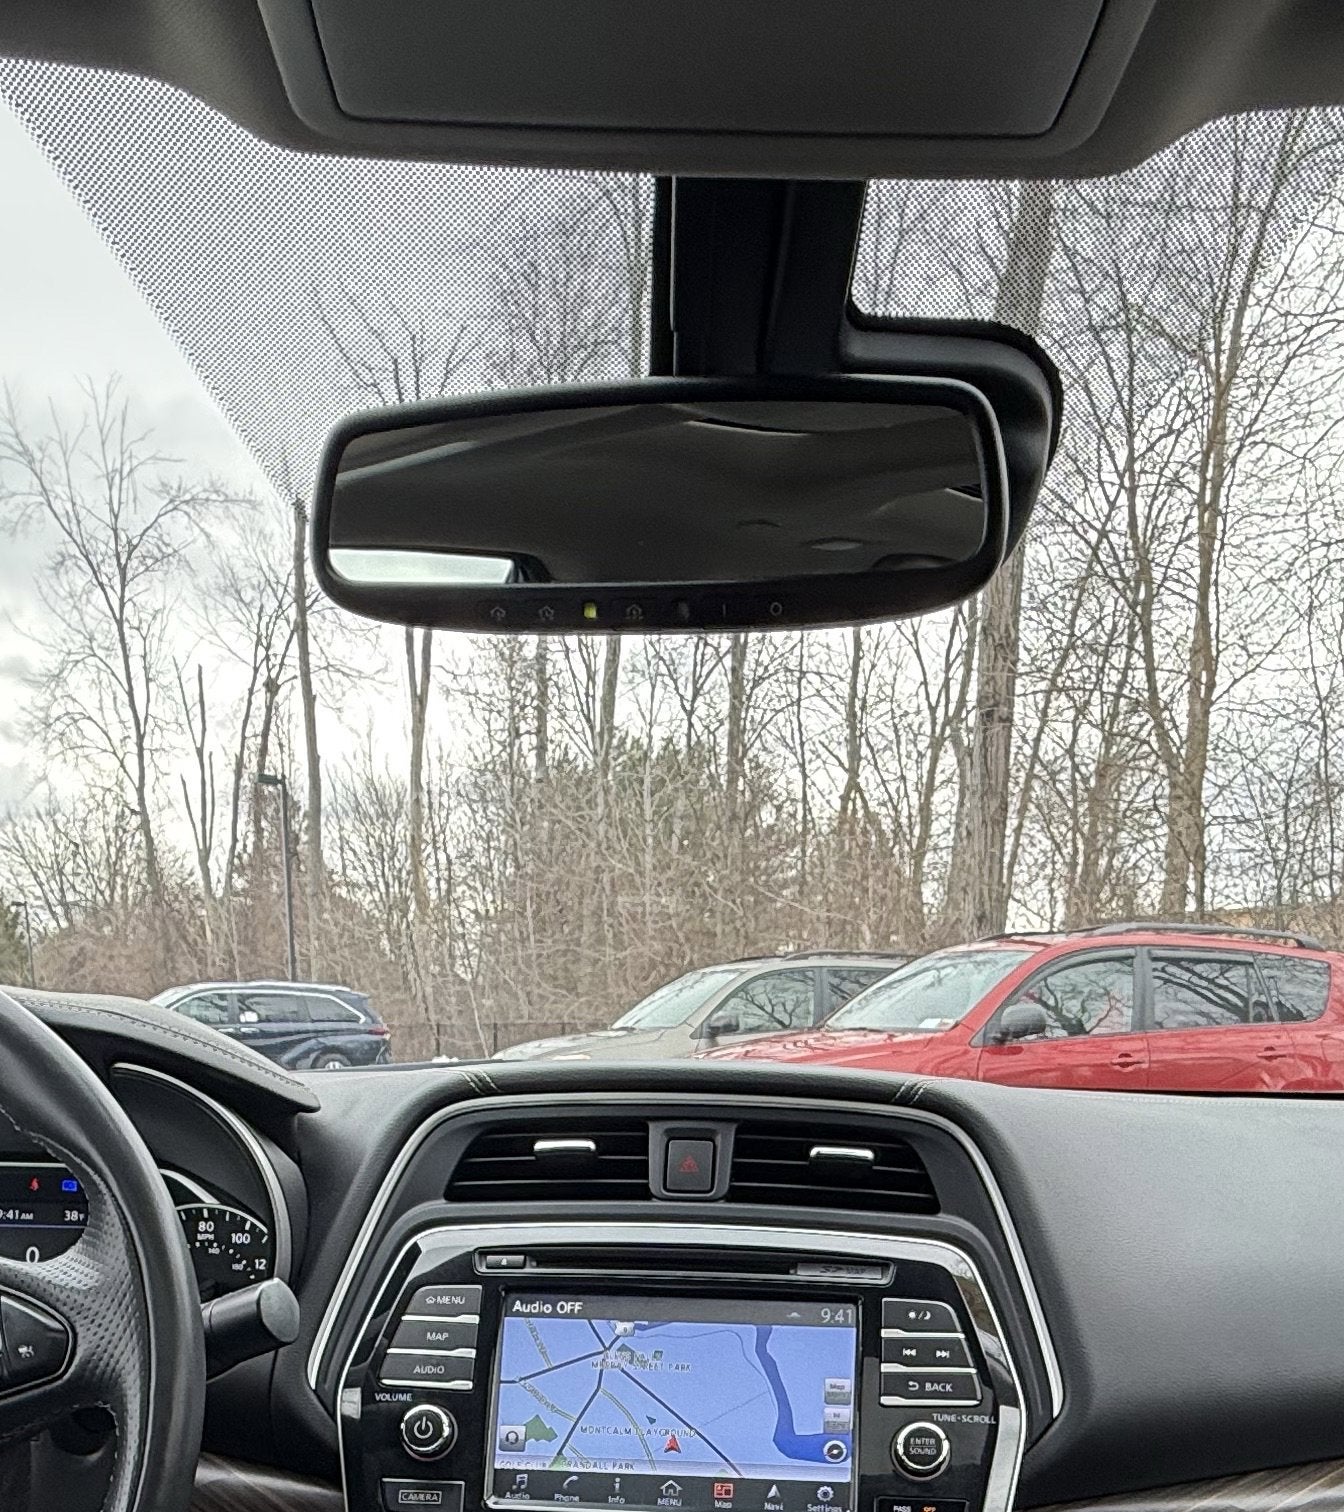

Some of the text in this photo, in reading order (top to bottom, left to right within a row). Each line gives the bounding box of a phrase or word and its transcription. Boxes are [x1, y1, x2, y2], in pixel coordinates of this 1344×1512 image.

[198, 1220, 215, 1233] 80
[231, 1232, 251, 1245] 100
[436, 1295, 466, 1305] MENU
[512, 1299, 584, 1315] Audio OFF
[820, 1307, 855, 1324] 9:41
[426, 1331, 449, 1341] MAP
[412, 1365, 445, 1375] AUDIO
[924, 1382, 953, 1393] BACK
[374, 1392, 413, 1402] VOLUME
[909, 1437, 936, 1446] ENTER
[908, 1446, 937, 1456] SOUND
[401, 1491, 440, 1502] CAMERA
[505, 1490, 531, 1501] Audio
[554, 1492, 580, 1503] Phone
[607, 1494, 626, 1504] Info
[657, 1497, 683, 1507] MENU
[714, 1499, 733, 1509] Map
